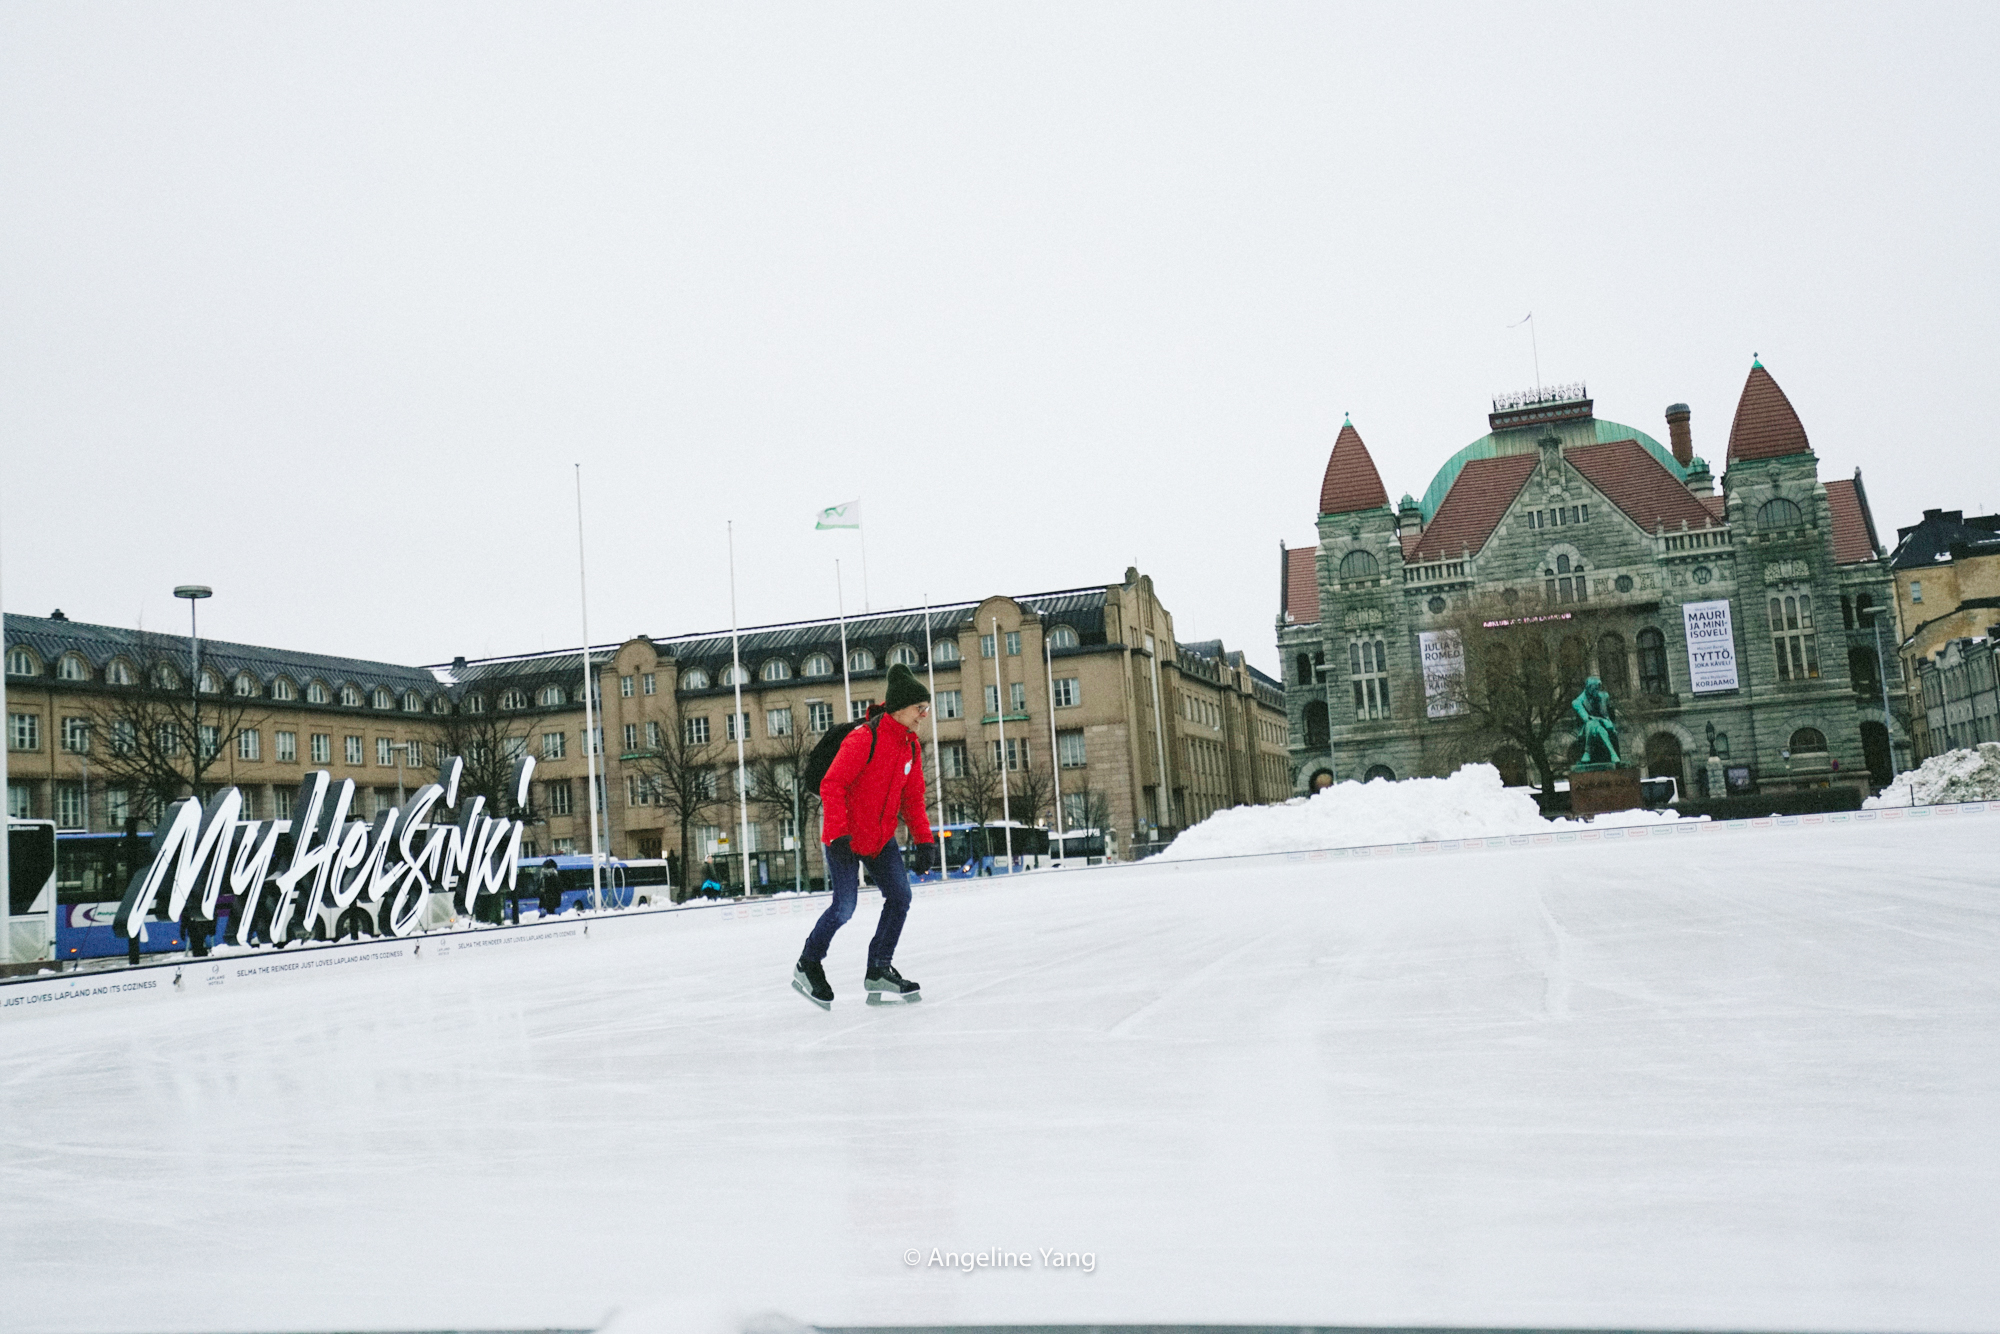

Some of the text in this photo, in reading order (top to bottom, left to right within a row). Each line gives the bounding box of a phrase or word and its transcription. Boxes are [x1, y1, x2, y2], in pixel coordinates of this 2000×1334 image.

[1688, 610, 1726, 622] MAURI
[1690, 619, 1728, 631] JA MINI-
[1690, 627, 1728, 639] ISOVELI
[1424, 641, 1450, 652] JULIA
[1425, 650, 1460, 661] ROMEO
[1692, 648, 1733, 662] TYTTÖ,
[1694, 659, 1731, 669] JOKA KÄVELI
[1695, 678, 1735, 688] KORJAAMO
[237, 950, 403, 978] SELMA THE REINDEER JUST LOVES LAPLAND AND ITS COZINESS
[4, 980, 157, 1007] JUST LOVES LAPLAND AND ITS COZINESS
